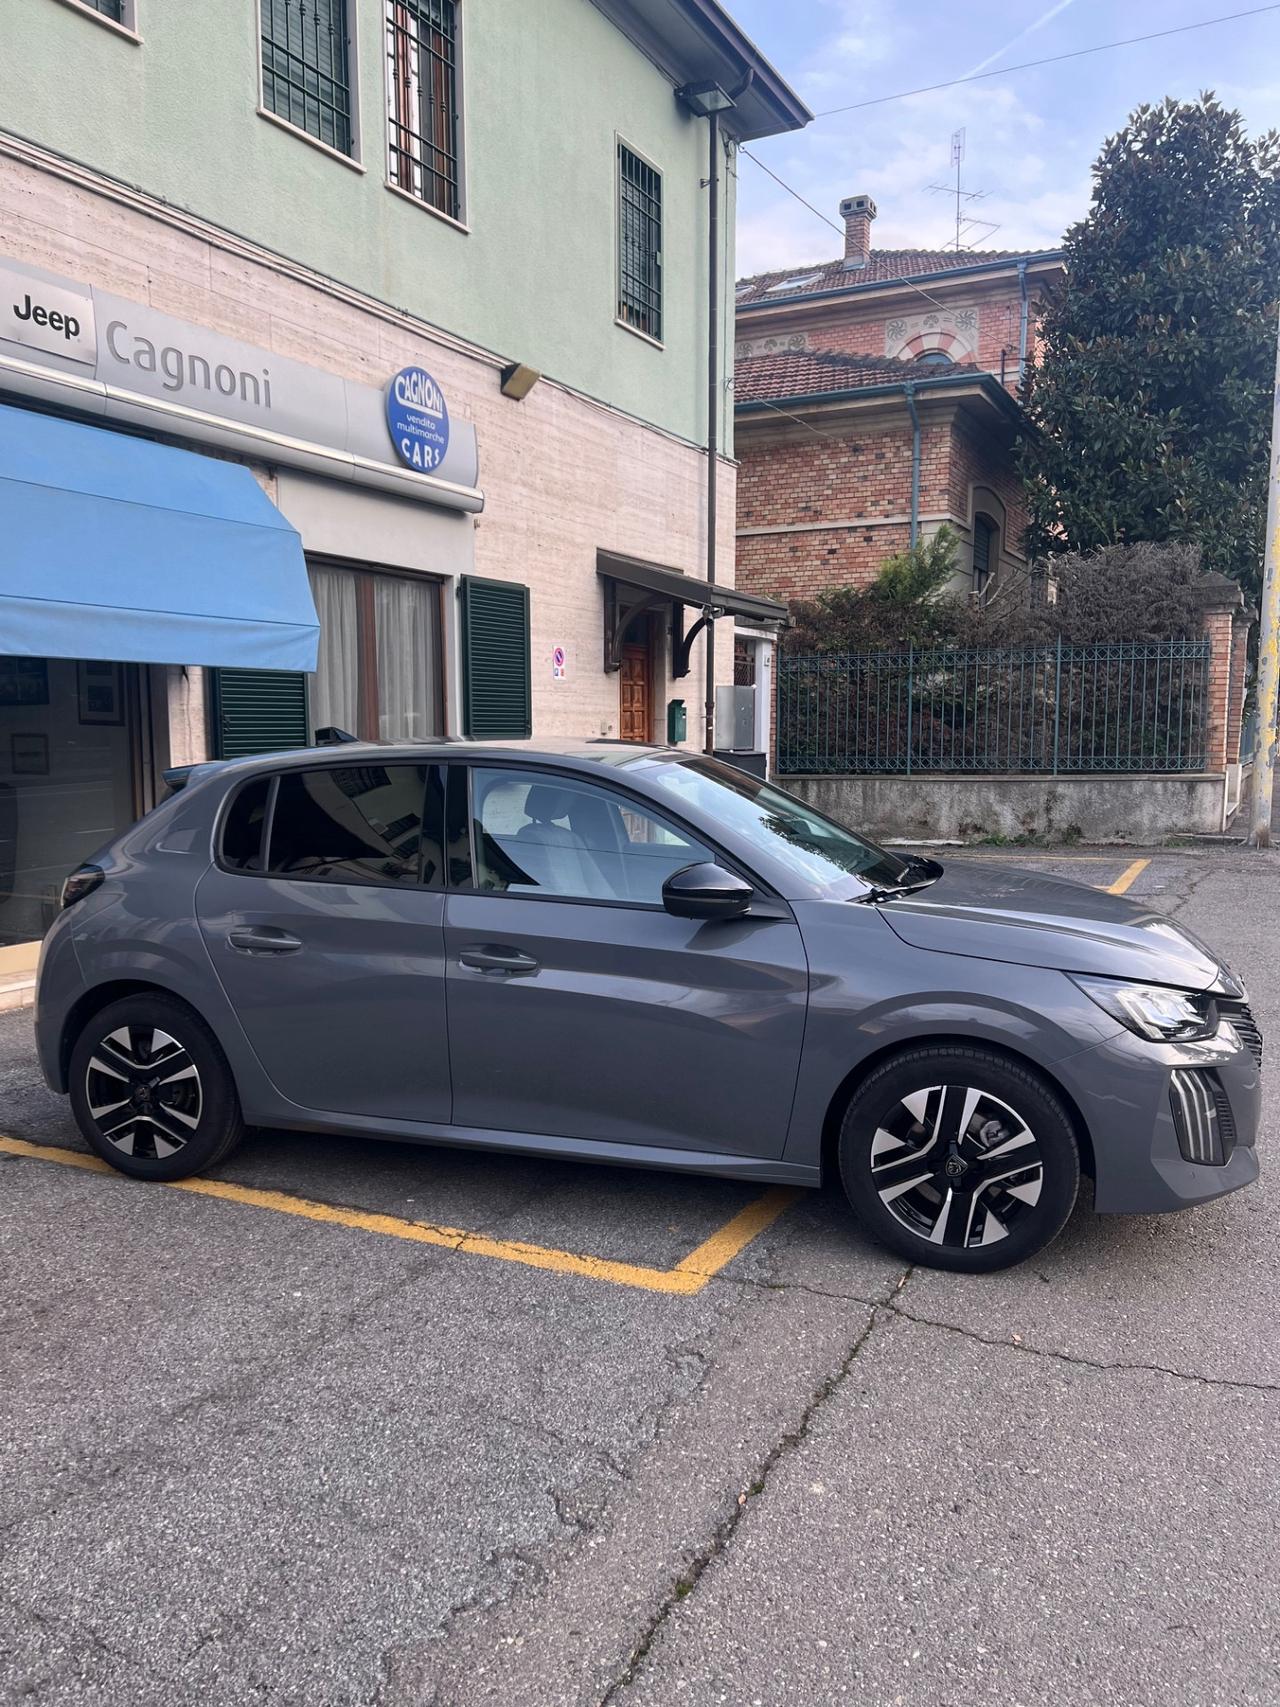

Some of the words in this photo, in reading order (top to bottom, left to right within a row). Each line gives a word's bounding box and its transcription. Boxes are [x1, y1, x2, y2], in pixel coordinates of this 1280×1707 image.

[13, 294, 81, 339] Jeep
[106, 320, 272, 408] Cagnoni
[395, 372, 443, 414] CAGNONI
[397, 422, 445, 444] multimarche
[401, 438, 440, 468] CARS
